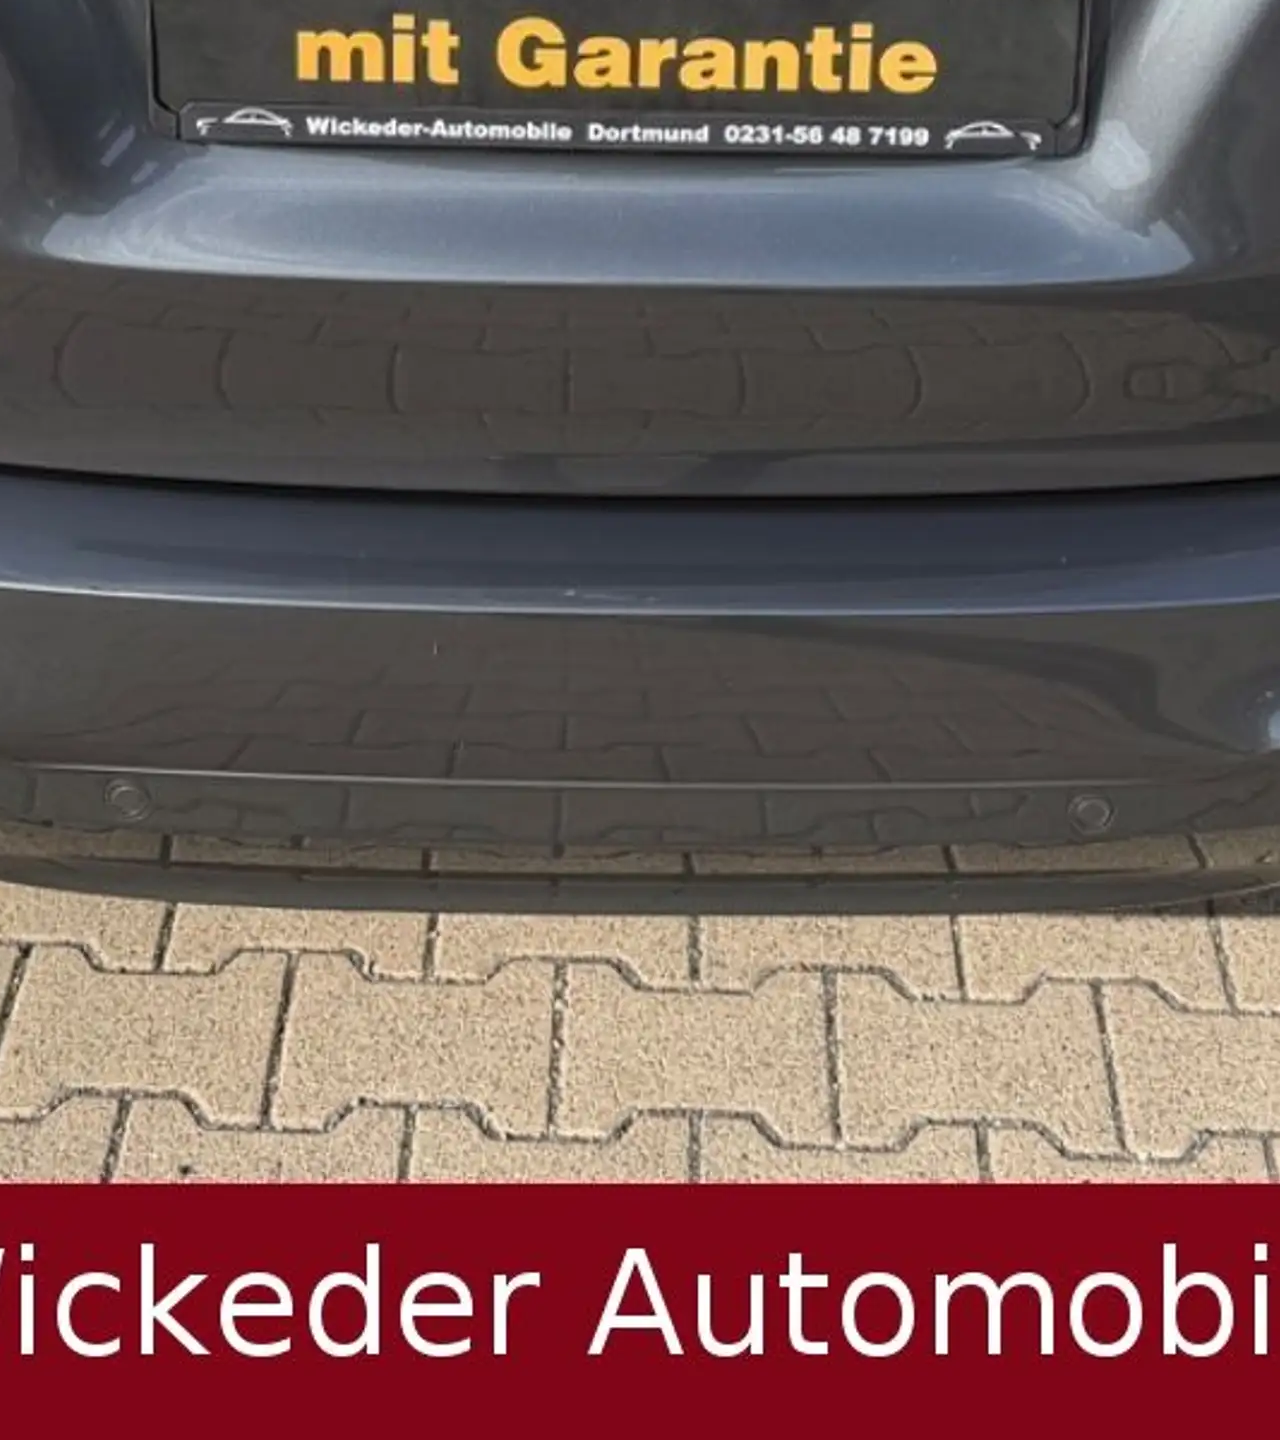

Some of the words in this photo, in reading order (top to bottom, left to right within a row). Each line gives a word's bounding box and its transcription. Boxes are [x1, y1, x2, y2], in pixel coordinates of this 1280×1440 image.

[296, 14, 460, 86] mit
[495, 17, 939, 94] Garantie
[305, 115, 574, 142] Wickeder-Automobile
[586, 122, 710, 144] Dortmund
[723, 123, 824, 145] 0231-56
[829, 125, 862, 146] 48
[867, 126, 930, 148] 7199
